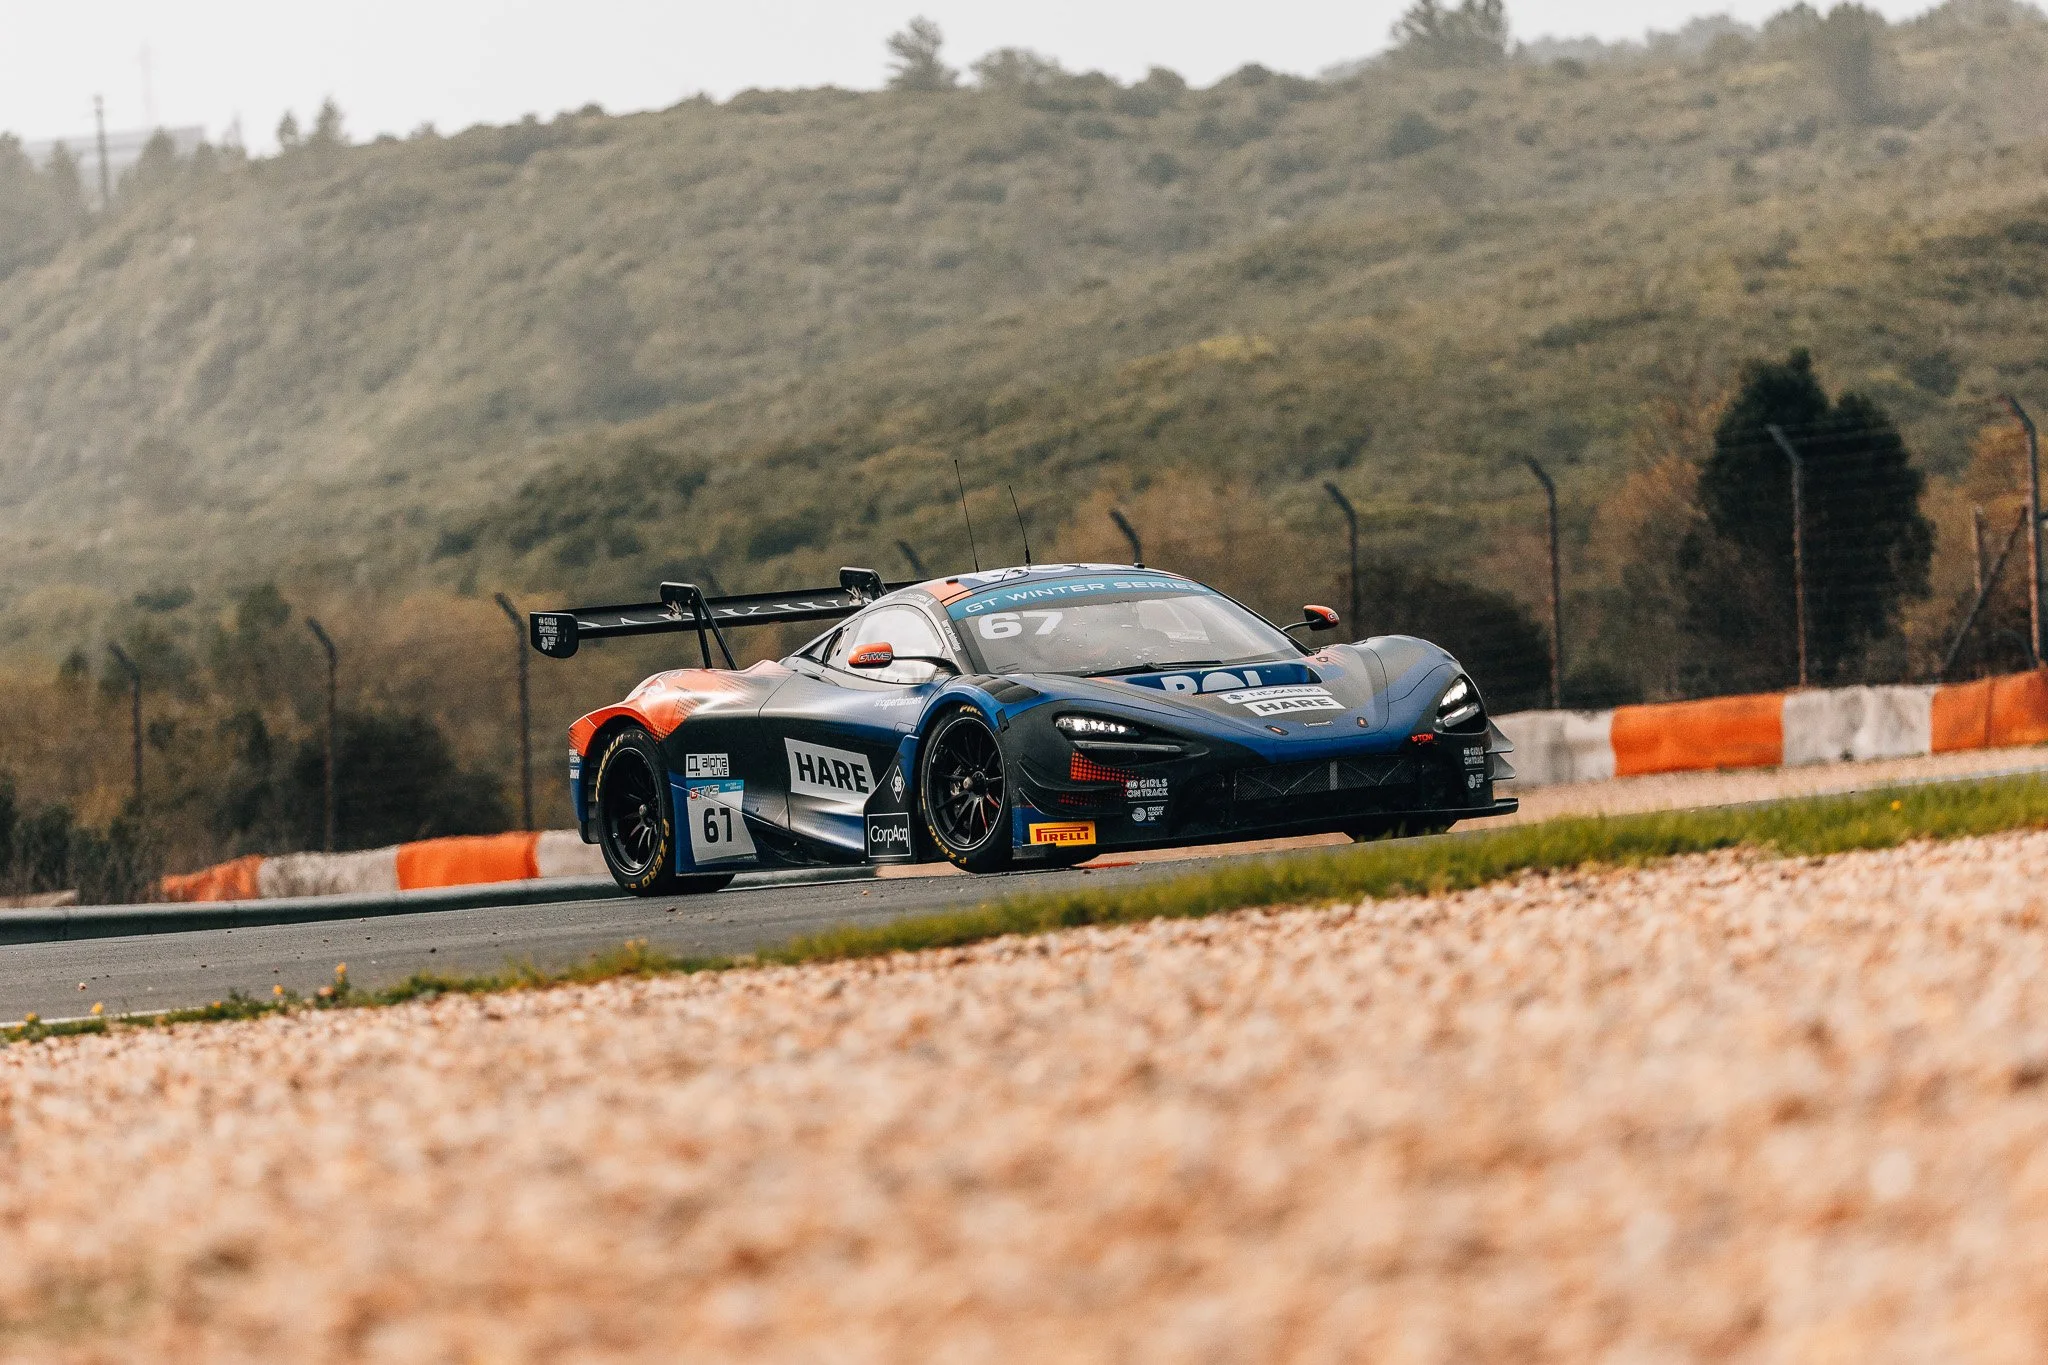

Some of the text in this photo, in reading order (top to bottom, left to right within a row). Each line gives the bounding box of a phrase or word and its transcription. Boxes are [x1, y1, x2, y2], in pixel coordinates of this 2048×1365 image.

[965, 581, 1207, 613] GT WINTER SERIES
[978, 611, 1064, 640] 67
[858, 651, 891, 662] GTWS
[1256, 698, 1334, 712] HARE
[702, 755, 728, 770] alpha
[712, 768, 728, 776] LIVE
[794, 751, 870, 794] HARE
[1139, 778, 1168, 788] GIRLS
[690, 785, 720, 799] GTWS
[703, 807, 733, 843] 67
[870, 824, 909, 849] CorpAcq
[1035, 826, 1089, 842] PIRELLI
